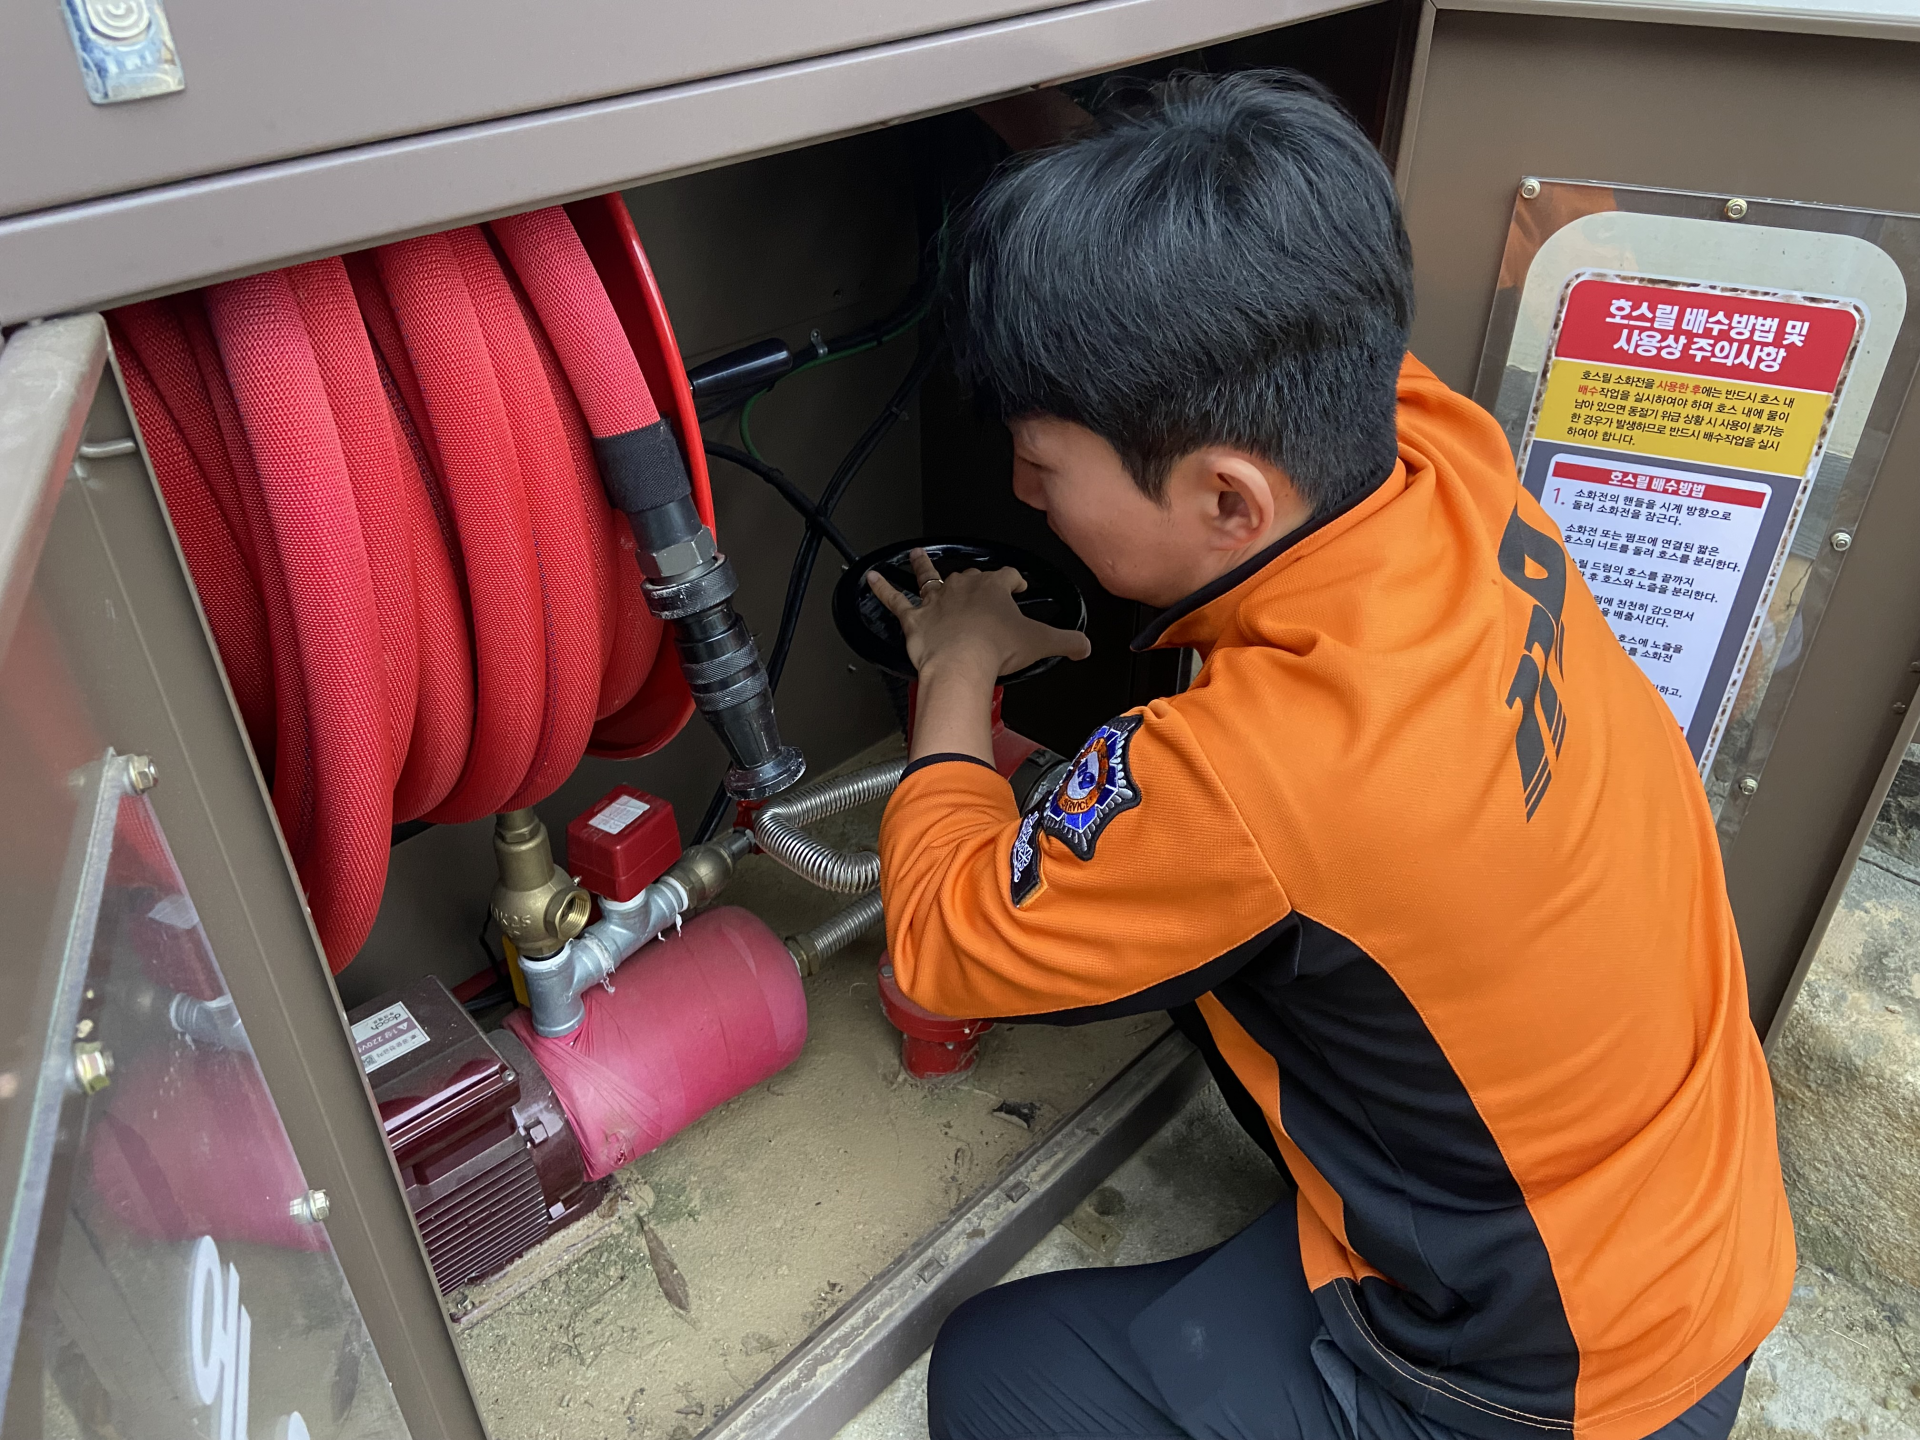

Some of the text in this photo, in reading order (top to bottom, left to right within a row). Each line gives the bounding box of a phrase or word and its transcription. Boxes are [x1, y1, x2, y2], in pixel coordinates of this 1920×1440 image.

[1605, 298, 1809, 346] 호스릴 배수방법 및
[1613, 328, 1786, 372] 사용상 주의사항
[1577, 384, 1790, 423] 배수작업을 실시하여야 하며 호스 내에 물이
[1580, 370, 1795, 408] 호스릴 소화전을 사용한 후에는 반드시 호스 내
[1570, 412, 1780, 451] 한 경우가 발생하므로 반드시 배수작업을 실시
[1574, 398, 1784, 437] 남아 있으면 동절기 위급 상황 시 사용이 불가능
[1566, 426, 1635, 445] 하여야 합니다.
[1553, 487, 1565, 505] 1.
[1608, 471, 1705, 497] 호스릴 배수방법
[1572, 499, 1681, 525] 돌려 소화전을 잠근다.
[1574, 489, 1731, 520] 소화전의 핸들을 시계 방향으로
[1565, 523, 1597, 537] 소화전
[1599, 529, 1622, 541] 또는
[1625, 532, 1658, 547] 펌프에
[1661, 538, 1694, 552] 연결된
[1563, 534, 1740, 572] 호스의 너트를 돌려 호스를 분리한다.
[1587, 572, 1598, 582] 후
[1600, 574, 1633, 588] 호스와
[1635, 580, 1669, 594] 노즐을
[1671, 586, 1717, 602] 분리한다.
[1590, 561, 1623, 575] 드럼의
[1625, 567, 1658, 581] 호스를
[1661, 573, 1694, 587] 끝까지
[1613, 610, 1668, 627] 배출시킨다.
[1616, 599, 1648, 613] 천천히
[1651, 605, 1694, 621] 감으면서
[1618, 633, 1683, 654] 호스에 노즐을
[1640, 650, 1673, 663] 소화전
